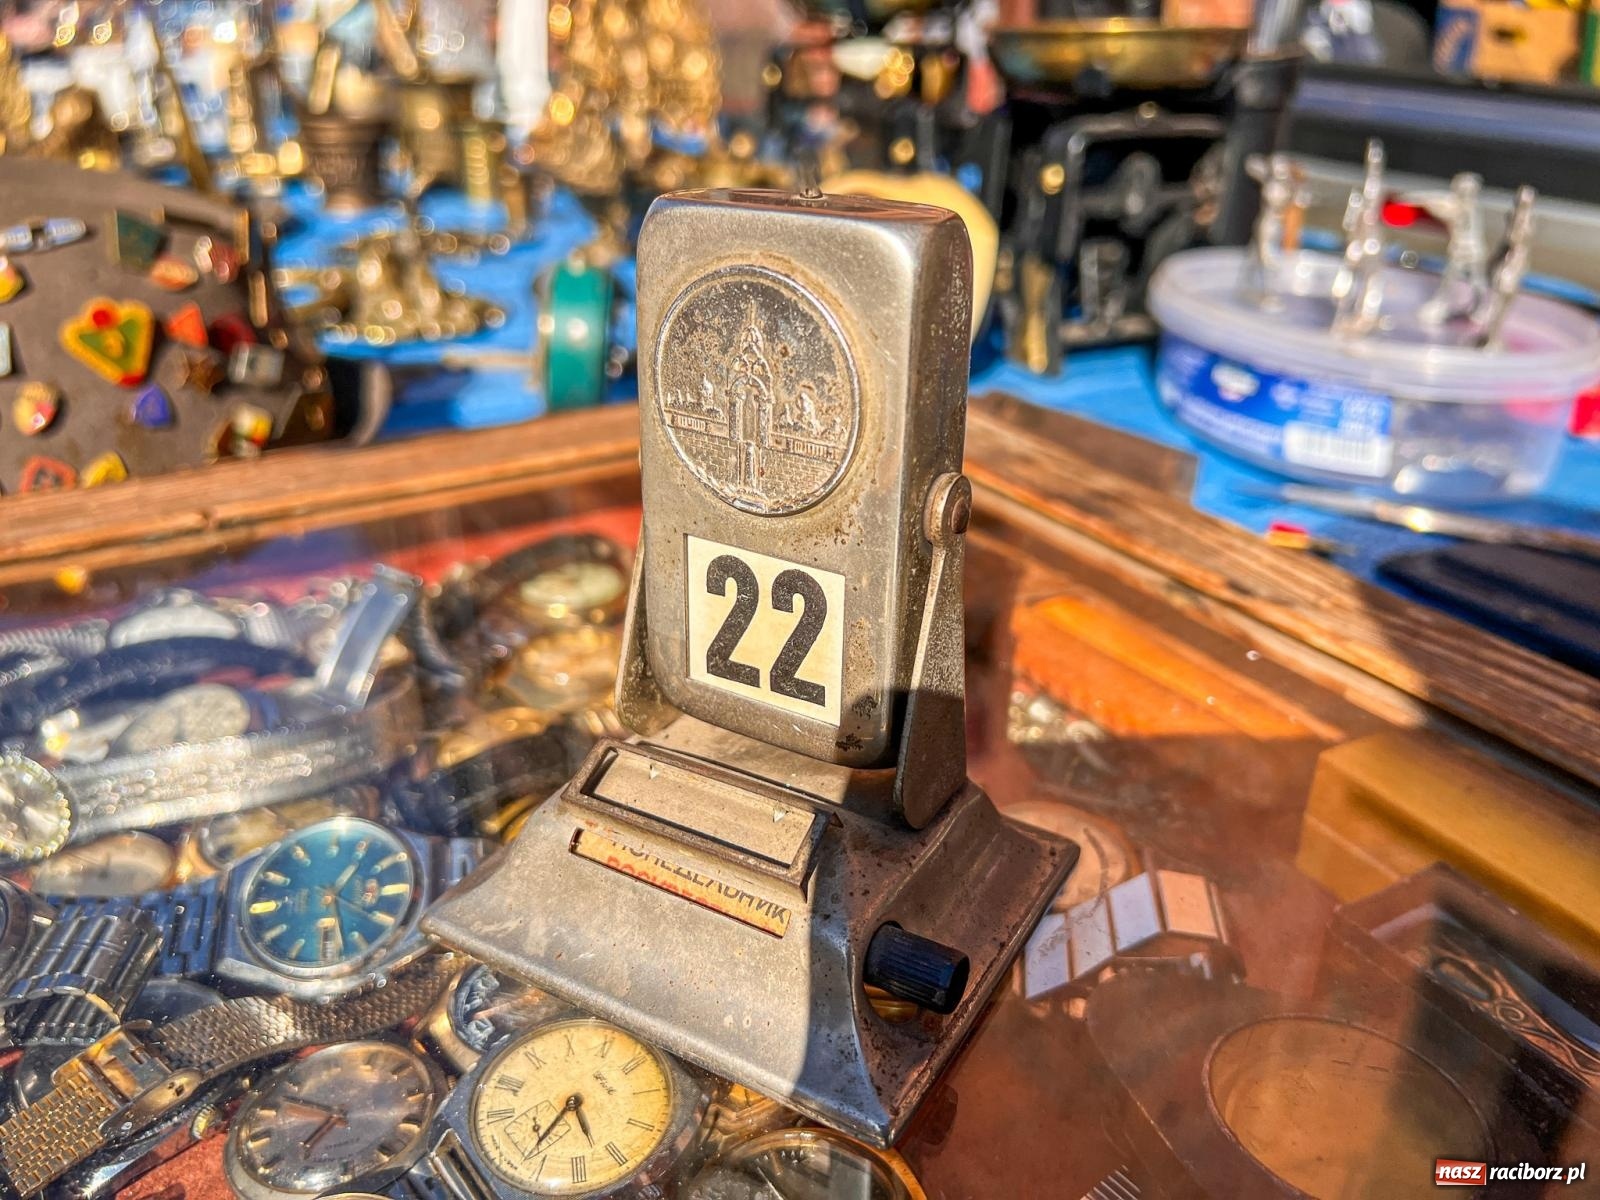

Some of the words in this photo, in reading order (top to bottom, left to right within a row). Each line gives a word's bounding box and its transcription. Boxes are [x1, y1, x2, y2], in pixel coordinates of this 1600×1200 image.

[706, 555, 827, 708] 22
[605, 1141, 629, 1168] III
[571, 1155, 587, 1184] IIII
